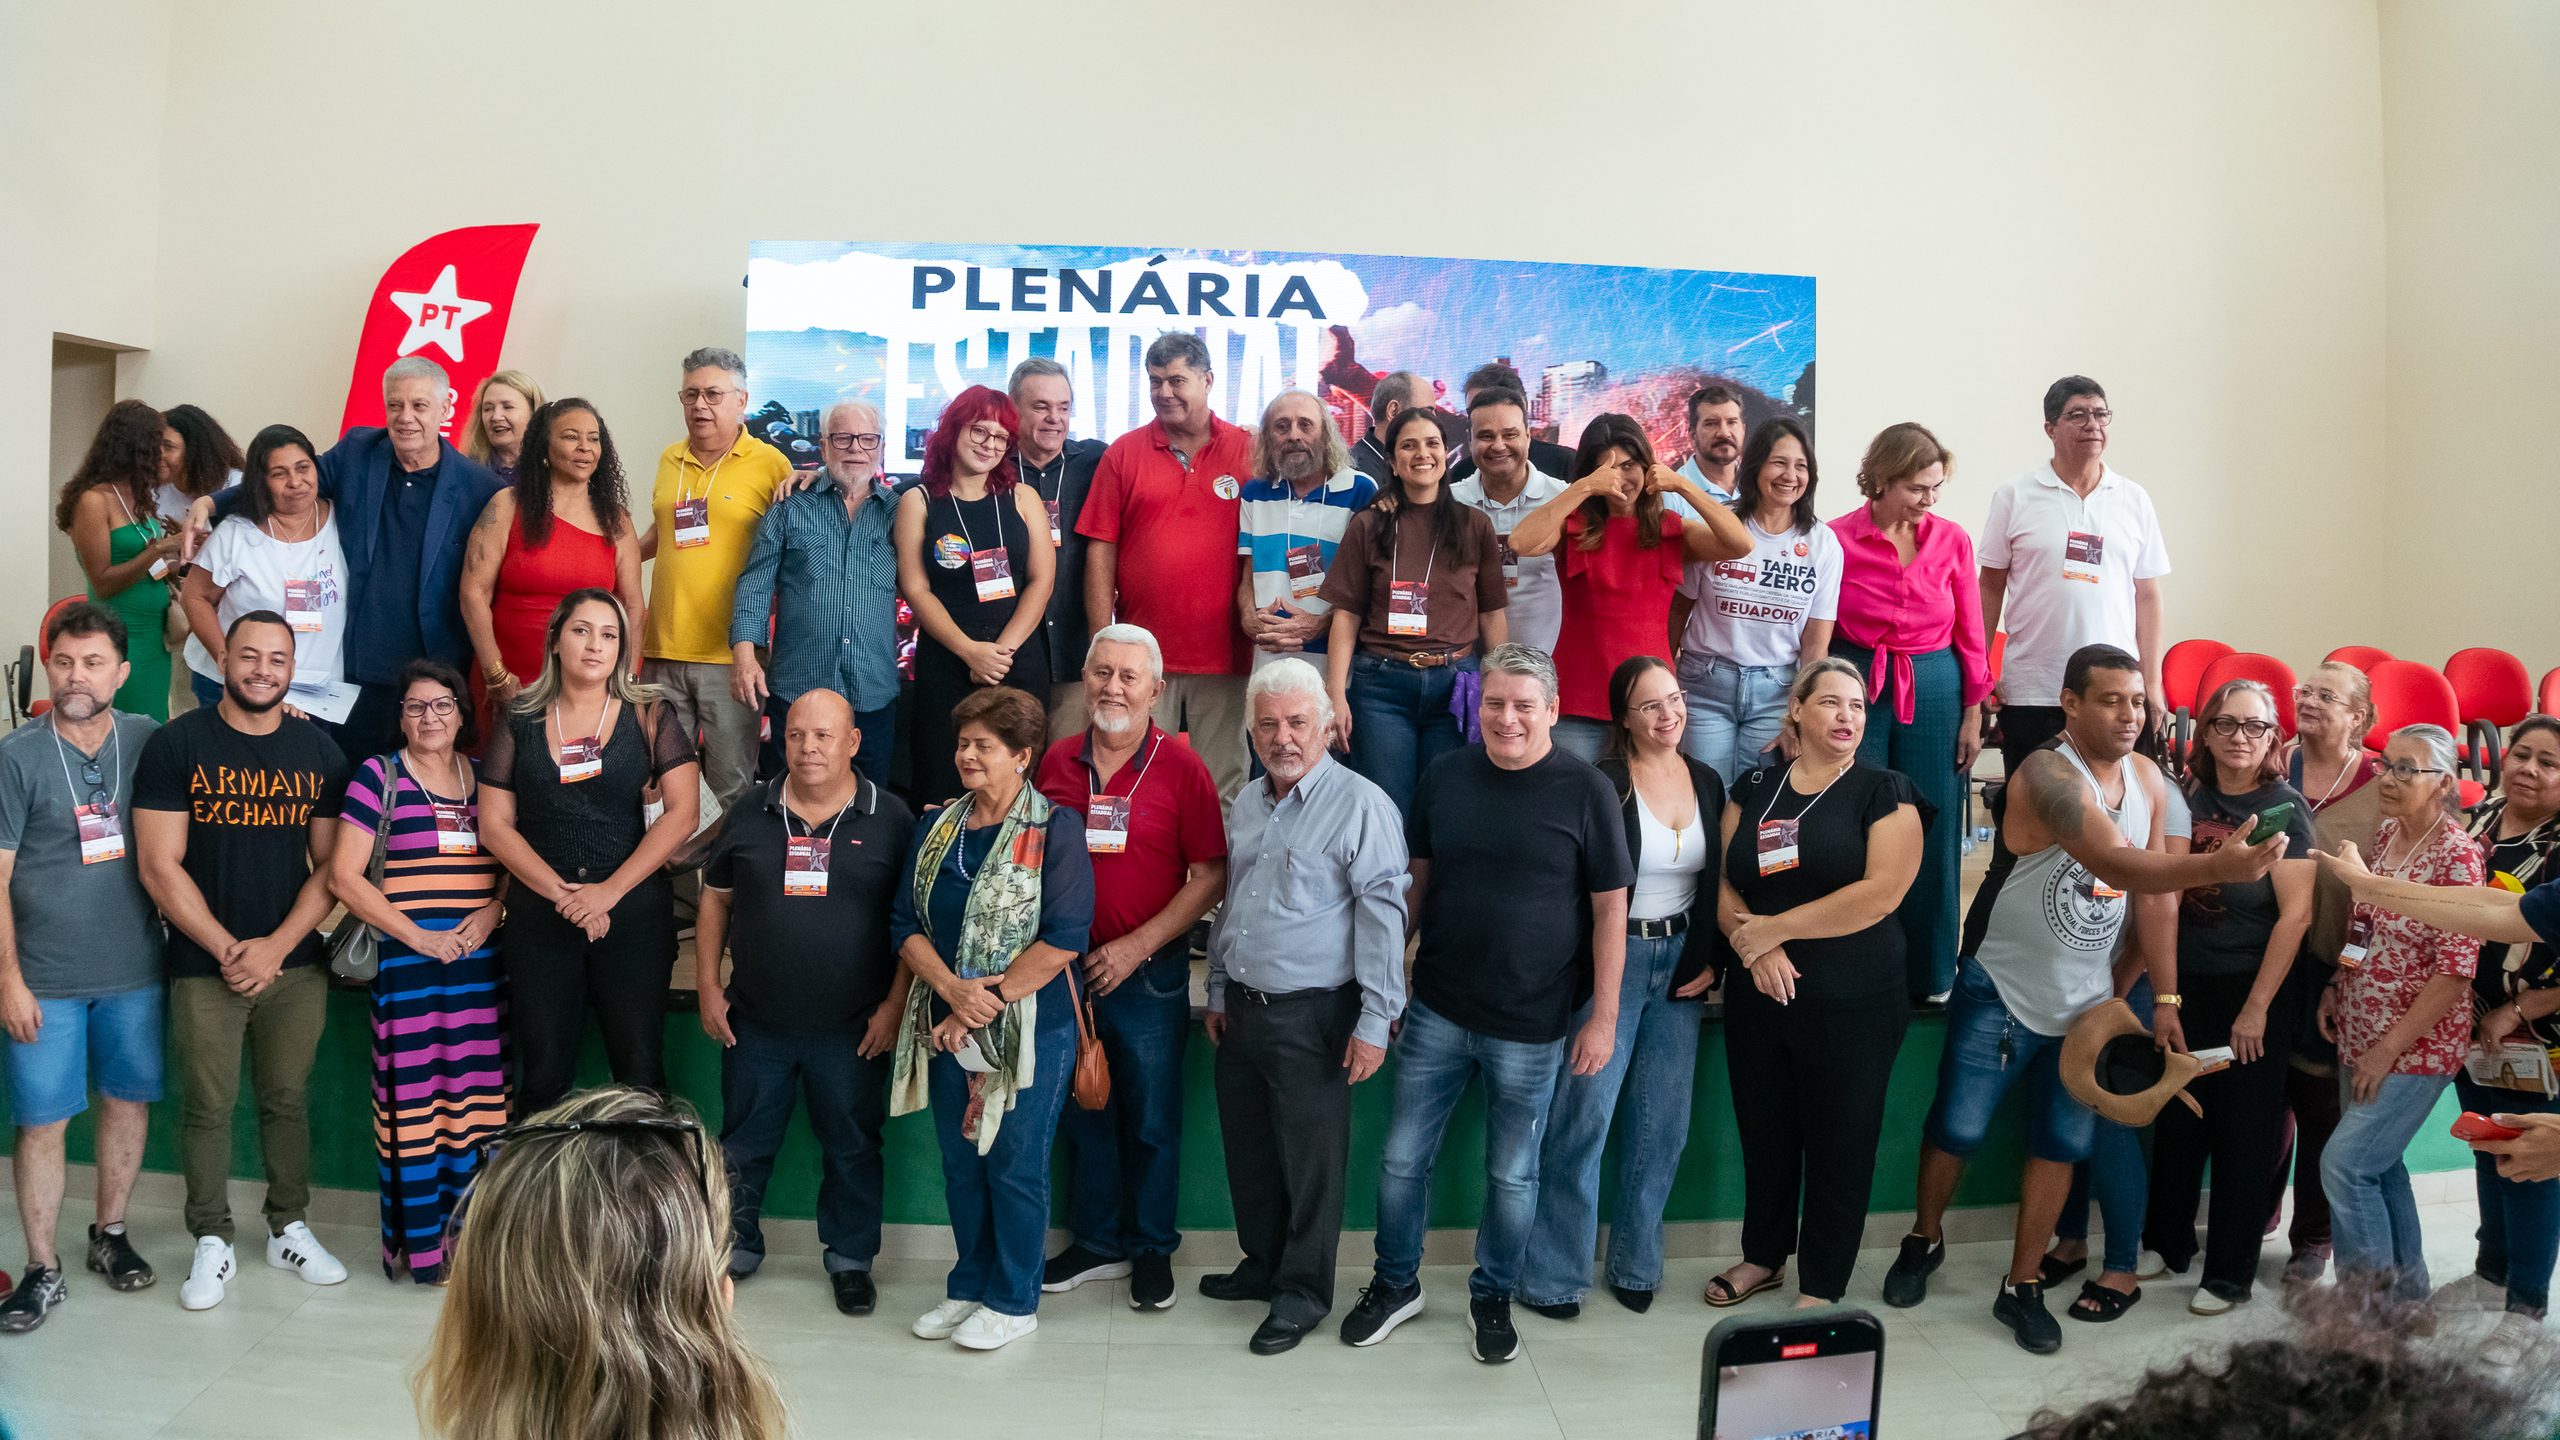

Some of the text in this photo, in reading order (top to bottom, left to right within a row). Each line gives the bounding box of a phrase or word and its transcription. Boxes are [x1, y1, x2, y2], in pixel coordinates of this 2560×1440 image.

[912, 254, 1327, 320] PLENÁRIA
[419, 303, 462, 330] PT
[1763, 559, 1816, 578] TARIFA
[1759, 571, 1816, 595] ZERO
[1720, 601, 1798, 621] #EUAPOIO
[2061, 902, 2079, 930] SPECIAL
[2077, 925, 2101, 936] FORCES
